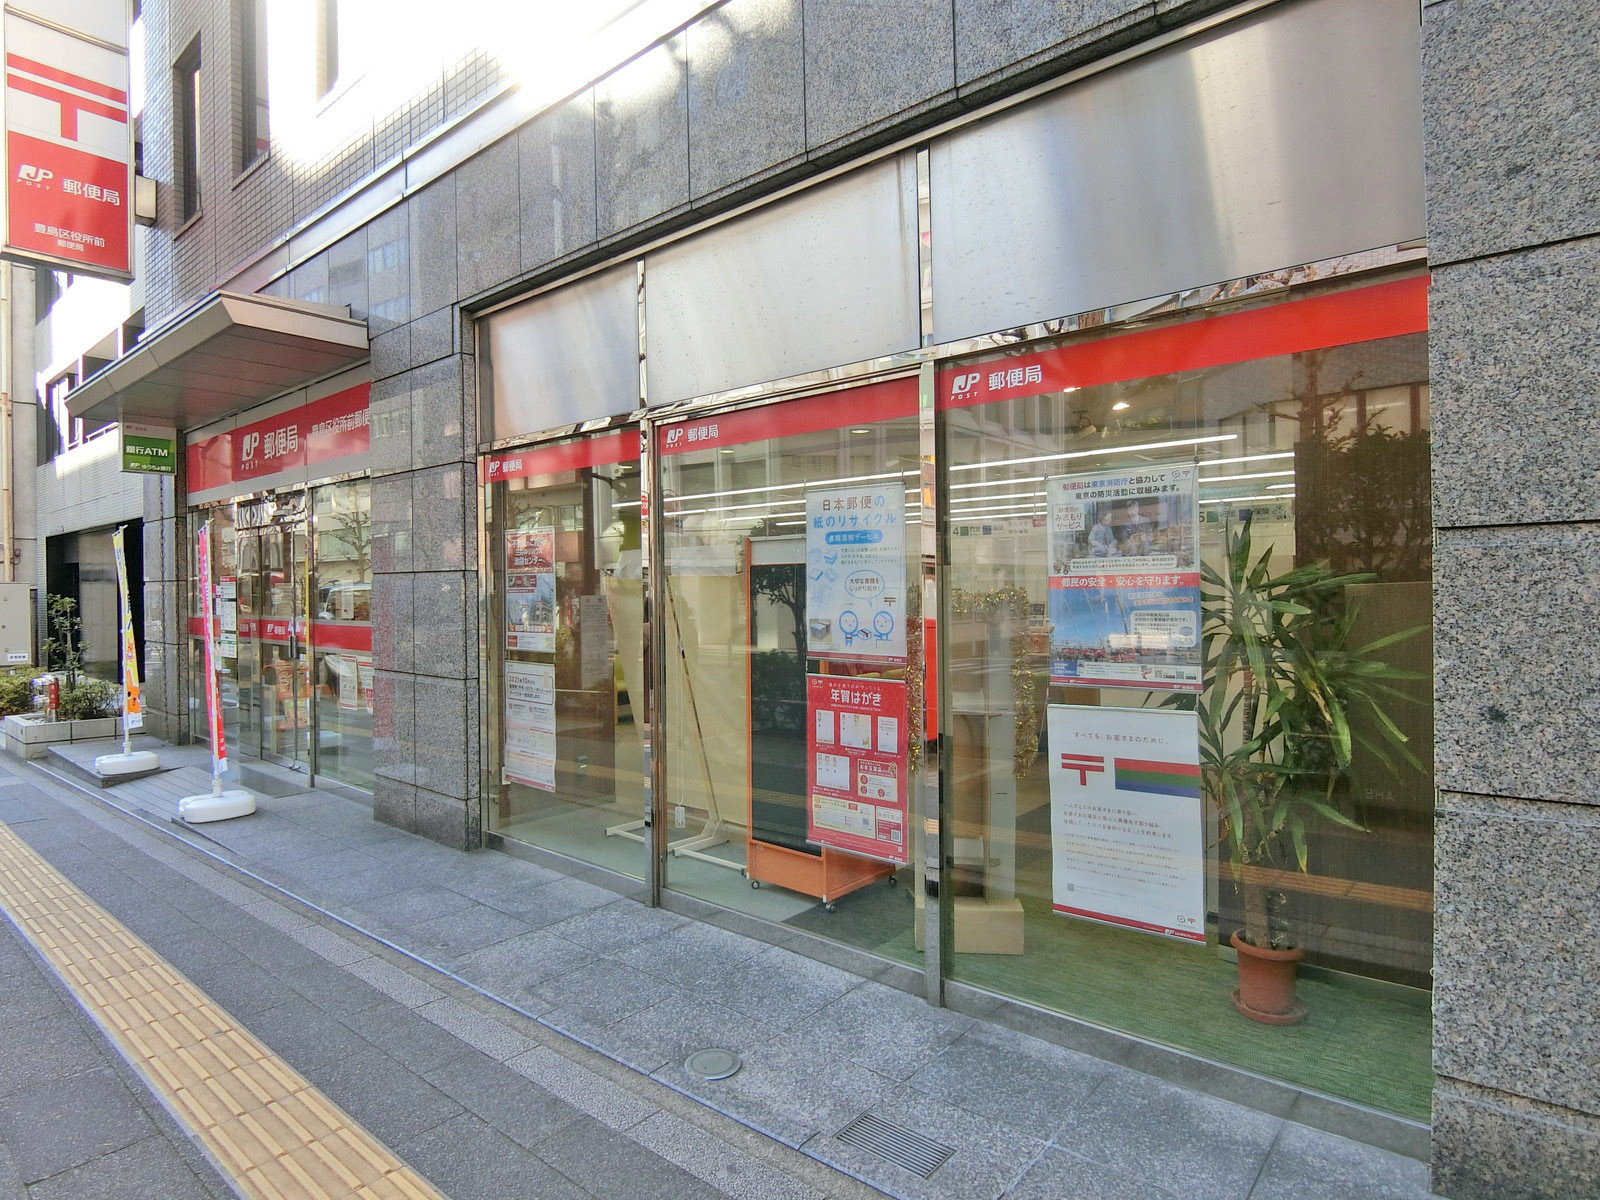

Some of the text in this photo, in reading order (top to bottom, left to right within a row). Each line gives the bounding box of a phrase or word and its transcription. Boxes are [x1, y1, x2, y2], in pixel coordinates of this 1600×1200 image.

[16, 178, 51, 191] POST
[63, 178, 120, 206] 郵便局
[34, 223, 105, 247] 豊島区役所前
[56, 239, 85, 252] 郵便局
[952, 373, 981, 394] JP
[988, 364, 1042, 391] 郵便局
[950, 391, 979, 401] POST
[667, 428, 684, 443] JP
[687, 424, 719, 442] 郵便局
[264, 424, 299, 460] 郵便局
[126, 445, 168, 457] 銀行ATM
[141, 464, 171, 472] ゆうちょ銀行
[241, 460, 259, 471] POST
[502, 459, 522, 473] 郵便局
[1062, 474, 1166, 491] 郵便局は東京消防庁と協力して
[1075, 484, 1181, 501] 東京の防災活動に取組みます。
[822, 495, 885, 511] 日本郵便の
[813, 513, 897, 529] 紙のリサイクル
[1055, 513, 1082, 522] みまもり
[952, 527, 959, 536] 4
[1056, 521, 1082, 530] サービス
[1061, 575, 1185, 588] 都民の安全・安心を守ります。
[509, 675, 535, 686] 2021年10月から
[831, 688, 882, 706] 年賀はがき
